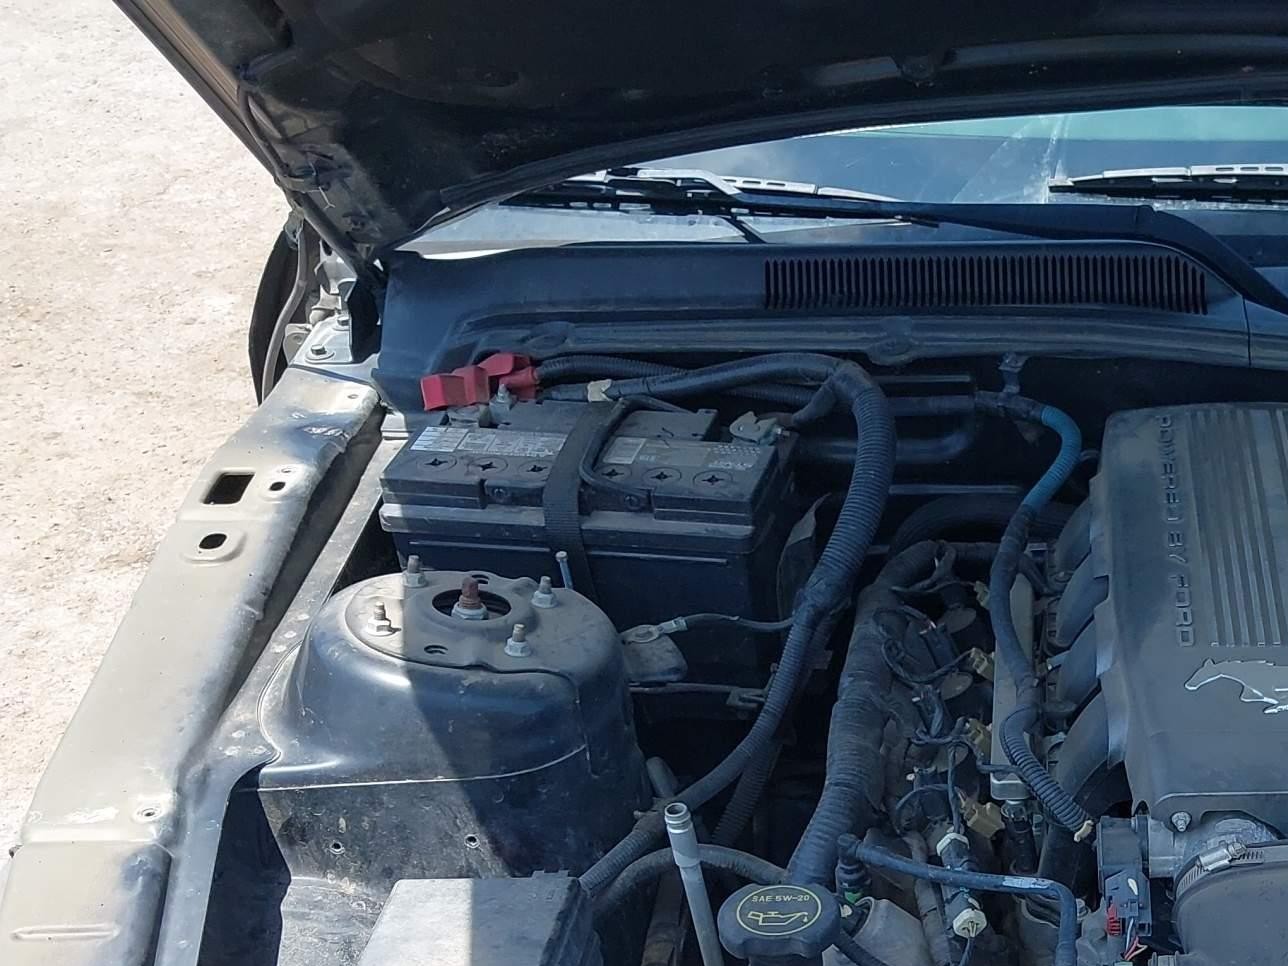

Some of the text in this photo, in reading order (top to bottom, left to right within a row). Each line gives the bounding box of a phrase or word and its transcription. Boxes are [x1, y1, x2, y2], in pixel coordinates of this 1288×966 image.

[1156, 415, 1195, 647] POWERED BY FORD
[775, 894, 810, 902] 5W-20
